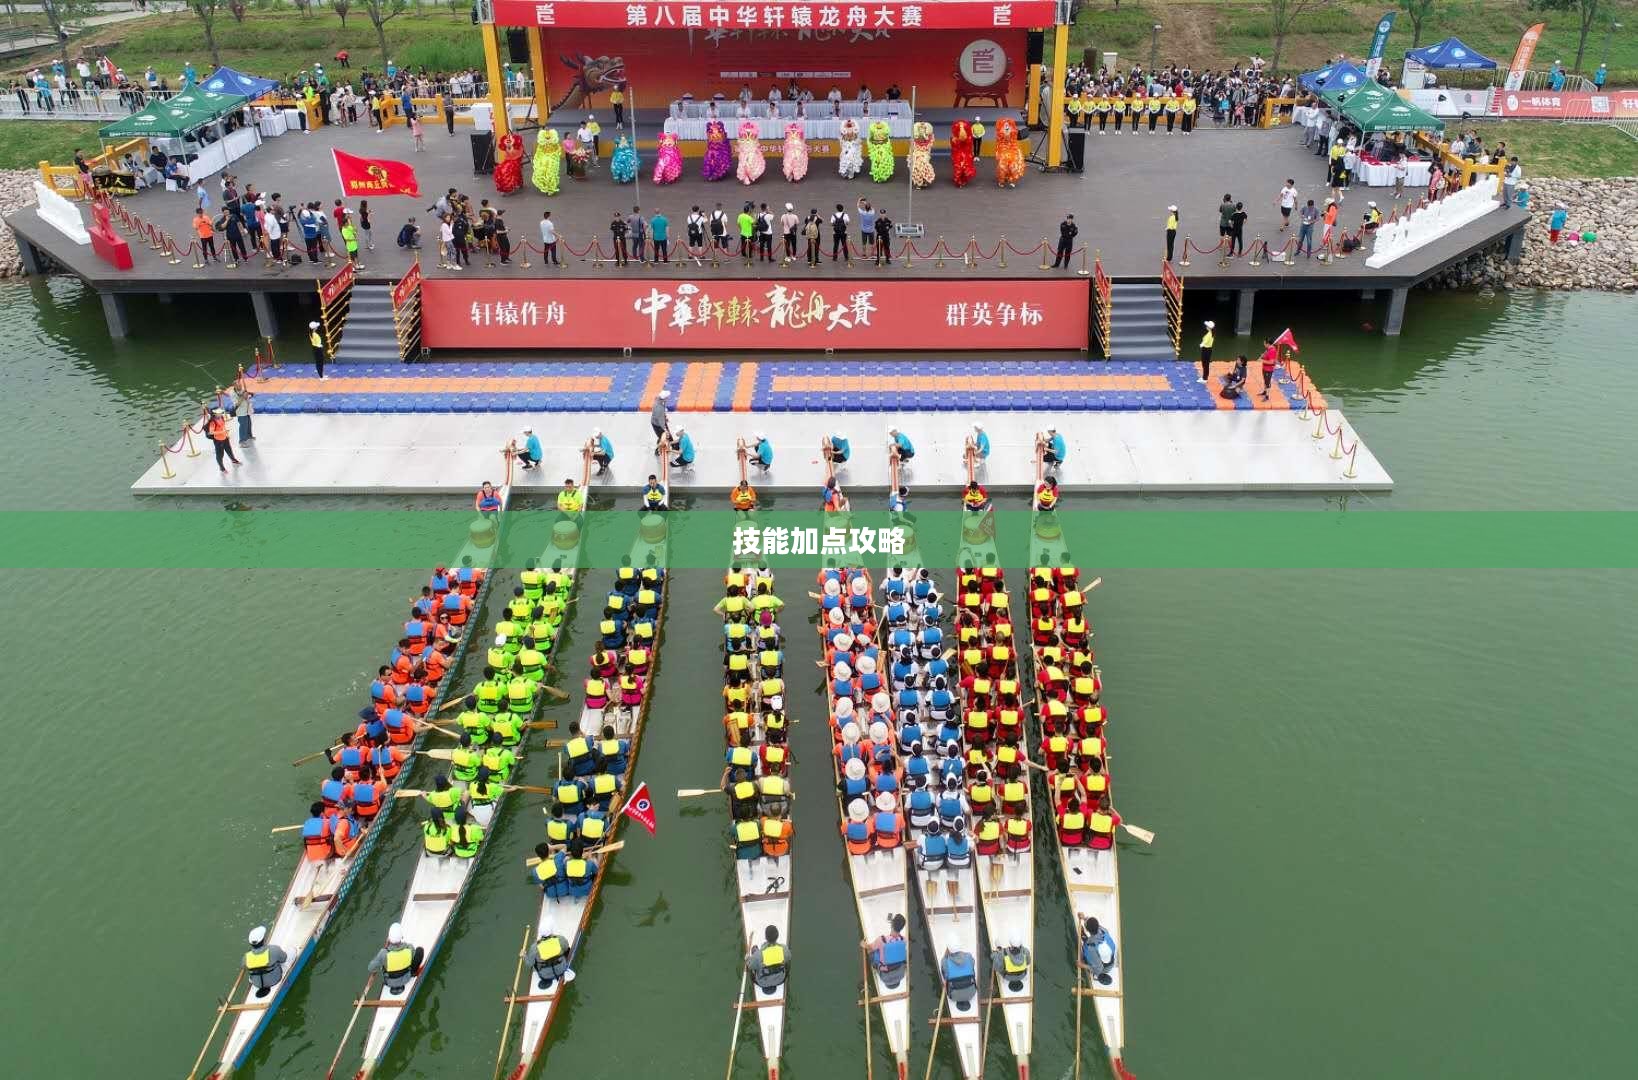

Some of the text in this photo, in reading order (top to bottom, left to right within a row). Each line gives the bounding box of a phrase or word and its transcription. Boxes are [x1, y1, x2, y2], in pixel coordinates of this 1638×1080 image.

[626, 4, 923, 27] 第八届中华轩辕龙舟大赛
[470, 301, 567, 326] 轩辕作舟
[946, 302, 1044, 326] 群英争标
